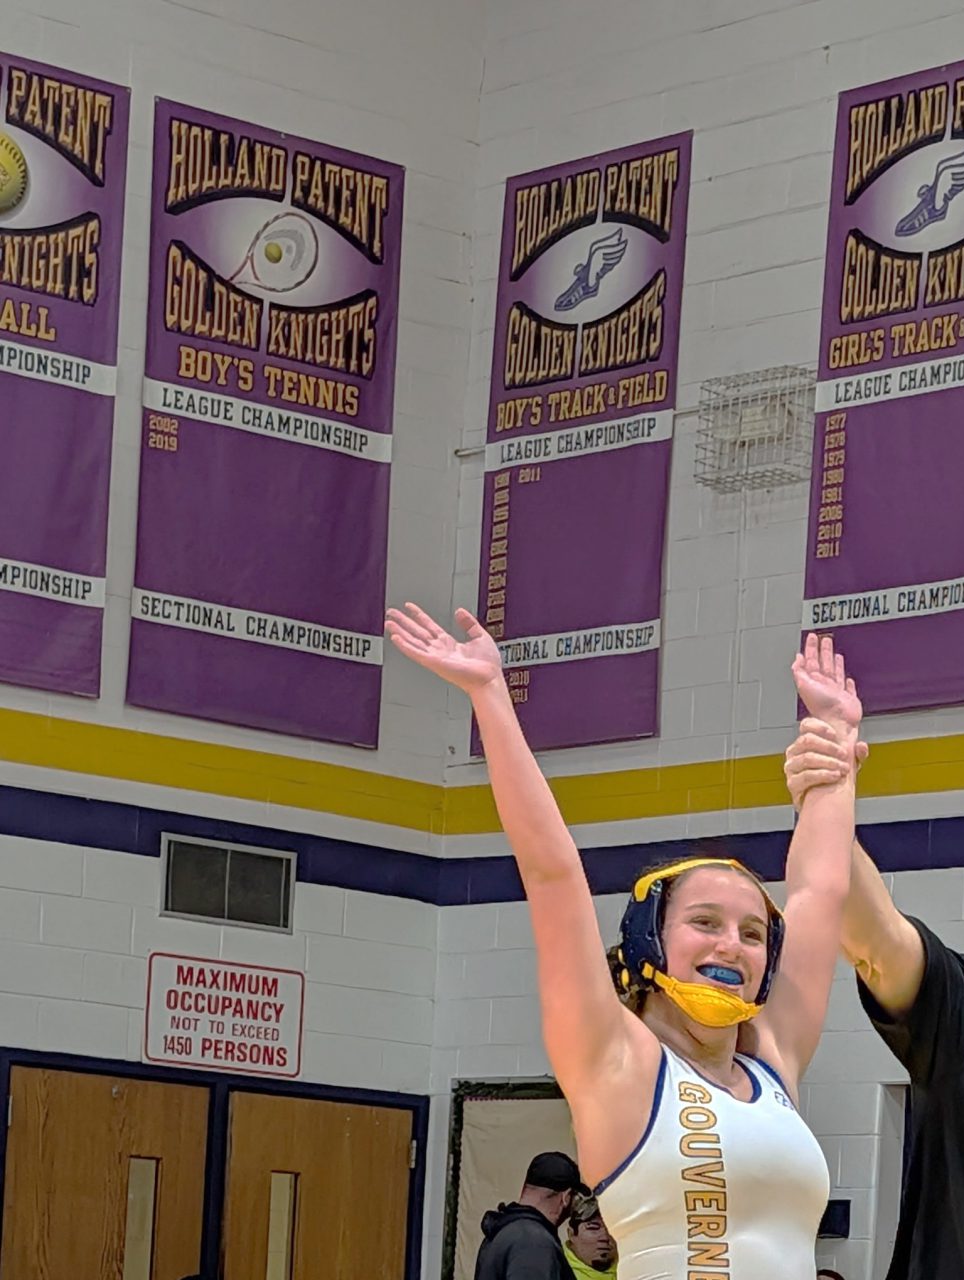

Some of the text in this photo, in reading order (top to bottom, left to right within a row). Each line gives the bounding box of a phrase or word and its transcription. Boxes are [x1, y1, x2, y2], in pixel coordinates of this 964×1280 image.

[6, 66, 114, 187] PATENT
[845, 82, 949, 205] HOLLAND
[165, 117, 389, 264] HOLLAND PATENT
[510, 147, 680, 282] HOLLAND PATENT
[0, 212, 101, 307] NIGHTS
[840, 228, 923, 325] GOLDEN
[164, 240, 377, 380] GOLDEN KNIGHTS
[504, 267, 667, 390] GOLDEN KNIGHTS
[0, 345, 91, 385] PIONSHIP
[829, 327, 885, 369] GIRL'S
[178, 345, 359, 416] BOY'S TENNIS
[834, 376, 893, 405] LEAGUE
[162, 387, 369, 453] LEAGUE CHAMPIONSHIP
[495, 395, 542, 433] BOY'S
[148, 432, 178, 452] 2019
[500, 417, 656, 464] LEAGUE CHAMPIONSHIP
[140, 596, 371, 658] SECTIONAL CHAMPIONSHIP
[812, 592, 890, 625] SECTIONAL
[498, 625, 655, 664] TIONAL CHAMPIONSHIP
[176, 964, 278, 998] MAXIMUM
[166, 989, 284, 1024] OCCUPANCY
[170, 1016, 280, 1042] NOT TO EXCEED
[163, 1035, 287, 1067] 1450 PERSONS
